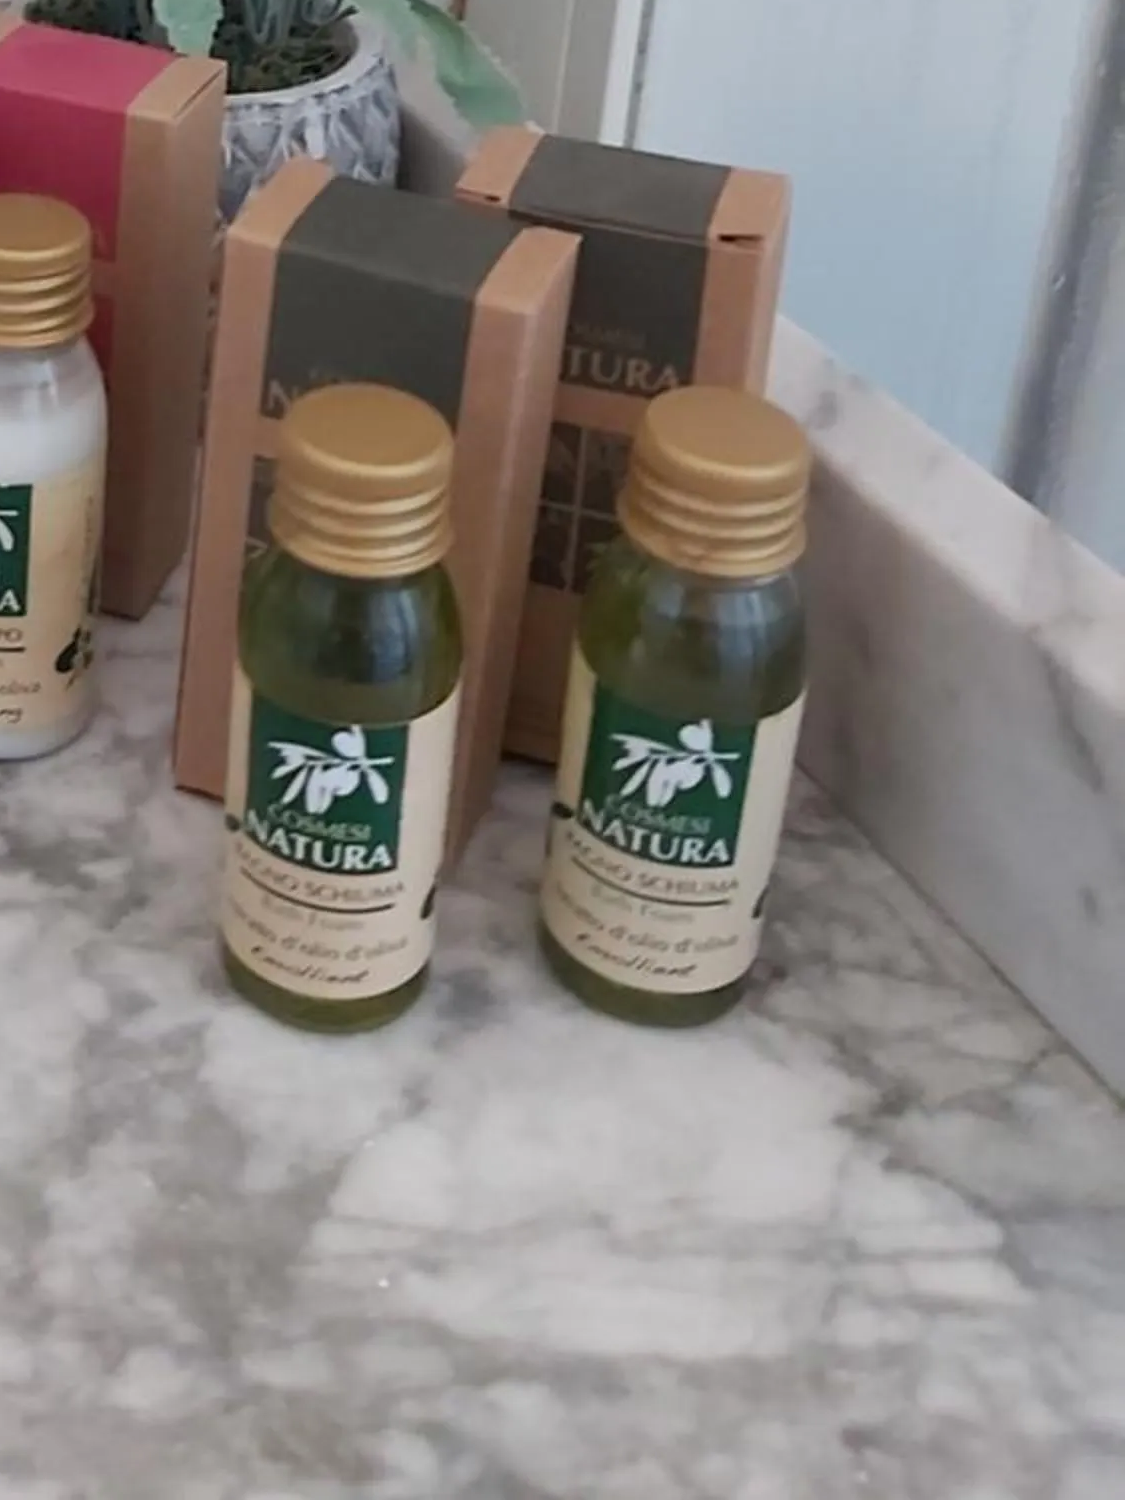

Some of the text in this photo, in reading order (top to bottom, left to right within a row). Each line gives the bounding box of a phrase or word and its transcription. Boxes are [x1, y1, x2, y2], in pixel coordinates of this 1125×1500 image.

[566, 345, 680, 392] TURA
[245, 809, 392, 870] NATURA
[581, 798, 731, 864] NATURA
